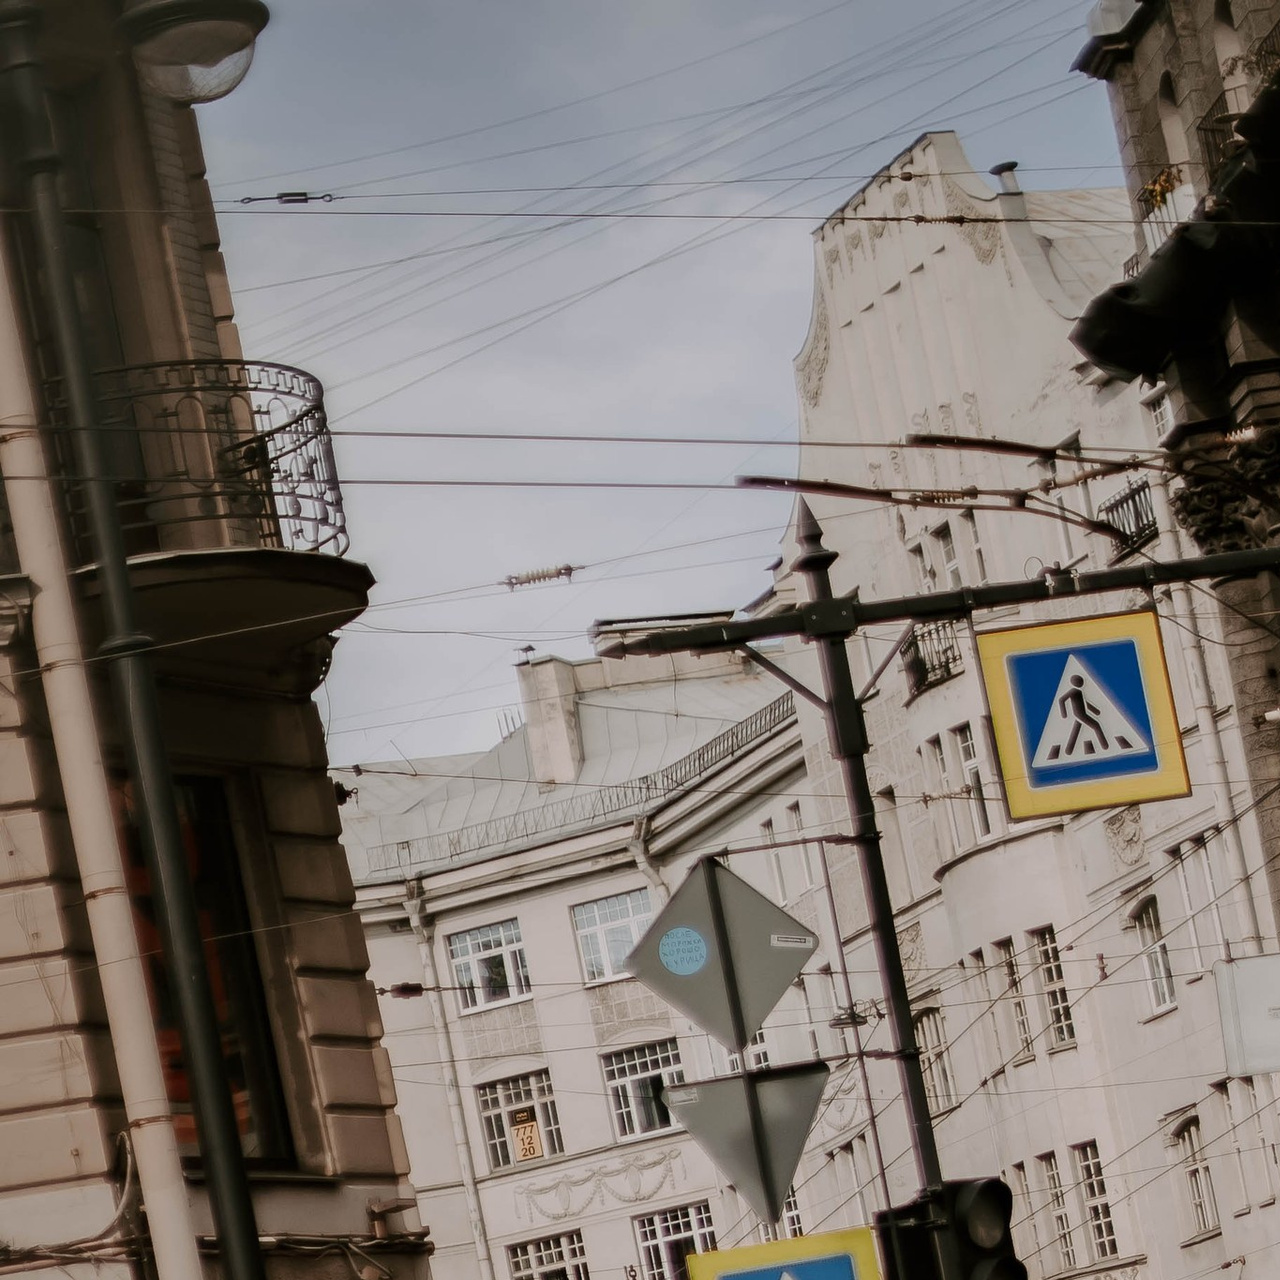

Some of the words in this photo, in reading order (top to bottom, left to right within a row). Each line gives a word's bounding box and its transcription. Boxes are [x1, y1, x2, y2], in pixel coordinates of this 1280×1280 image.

[514, 1125, 534, 1137] 777
[521, 1136, 534, 1146] 12
[521, 1146, 535, 1157] 20
